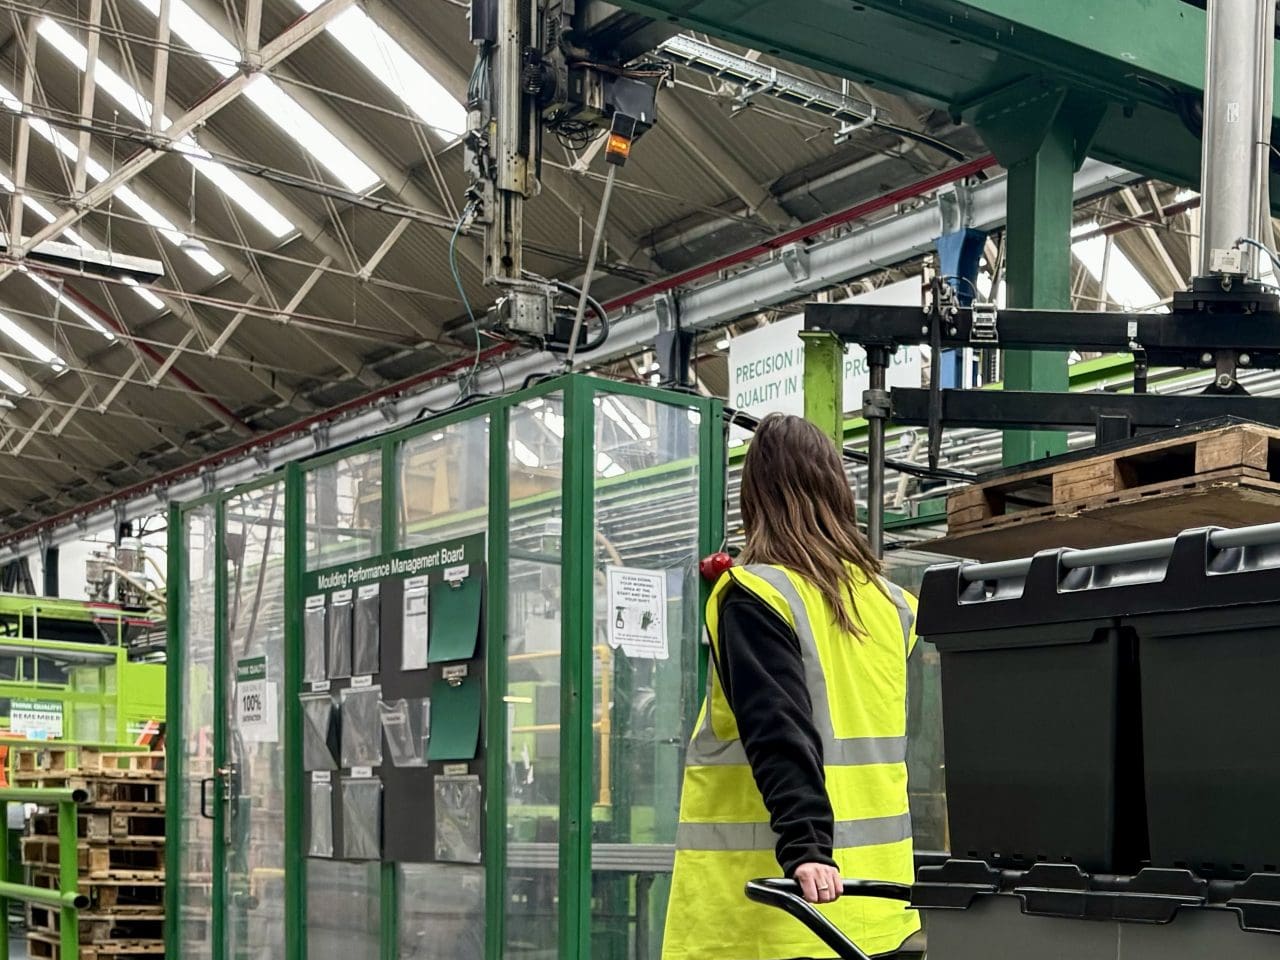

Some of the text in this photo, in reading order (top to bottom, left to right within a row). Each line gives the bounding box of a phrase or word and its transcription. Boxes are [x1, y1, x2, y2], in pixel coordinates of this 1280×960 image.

[736, 349, 793, 384] PRECISION
[736, 346, 912, 409] QUALITY IN PROCT.
[318, 544, 464, 589] Moulding Performance Management Board
[243, 694, 262, 712] 100%
